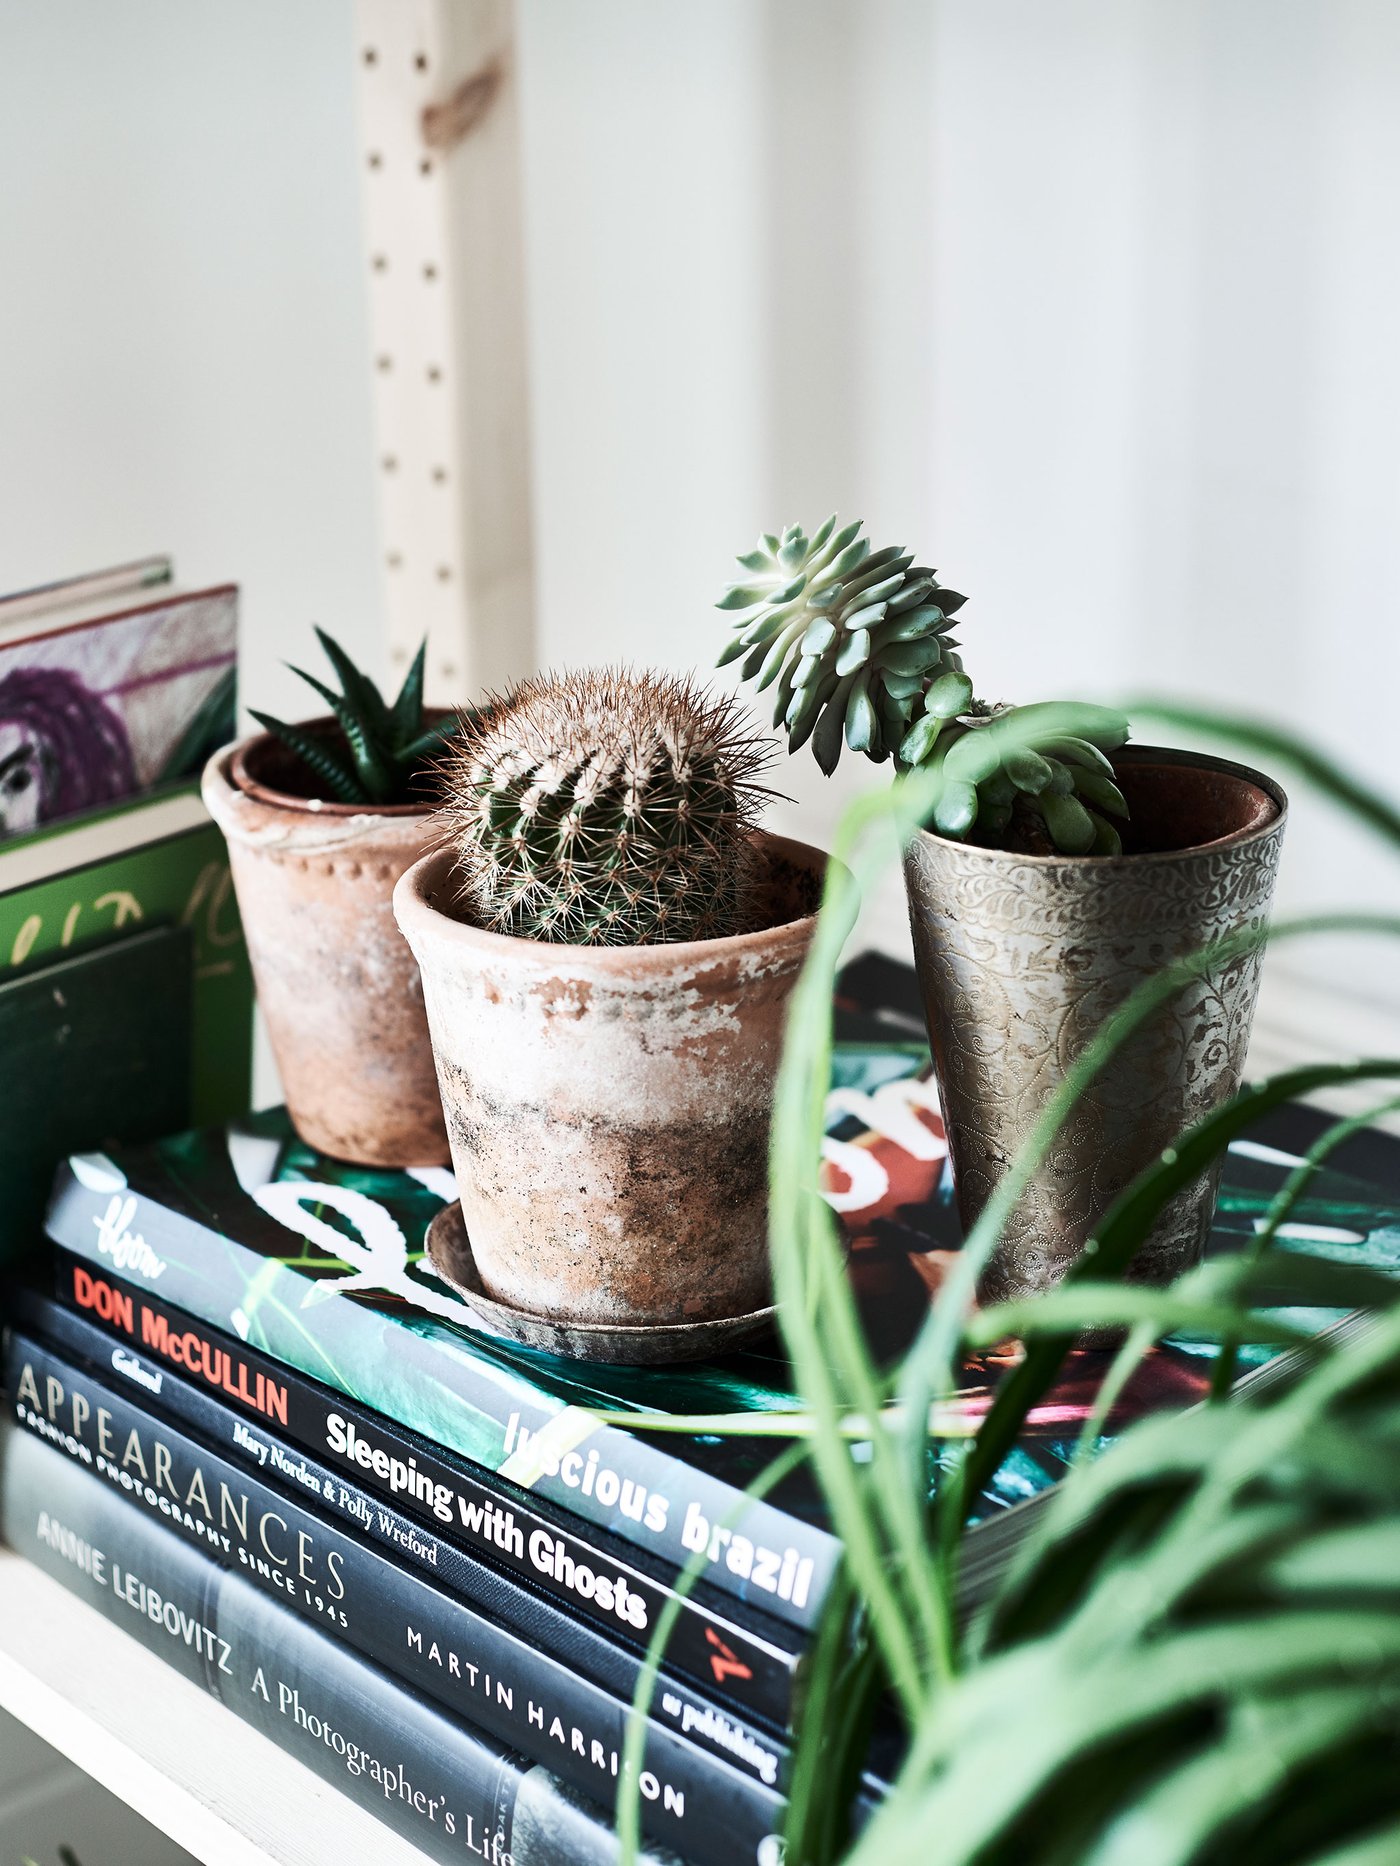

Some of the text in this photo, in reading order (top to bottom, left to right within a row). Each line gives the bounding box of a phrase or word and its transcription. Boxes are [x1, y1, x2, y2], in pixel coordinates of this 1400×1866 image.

[16, 1363, 346, 1600] APPEARANCES
[16, 1404, 348, 1628] FASHION PHOTOGRAPHY SINCE 1945
[73, 1266, 648, 1630] DON McCULLIN Sleeping with Ghosts
[233, 1422, 438, 1567] Mary Norden & Polly Wreford
[37, 1510, 108, 1586] ANNIE
[112, 1564, 233, 1675] LEIBOVITZ
[251, 1667, 270, 1702] A
[681, 1502, 815, 1609] brazil
[407, 1626, 513, 1712] MARTIN
